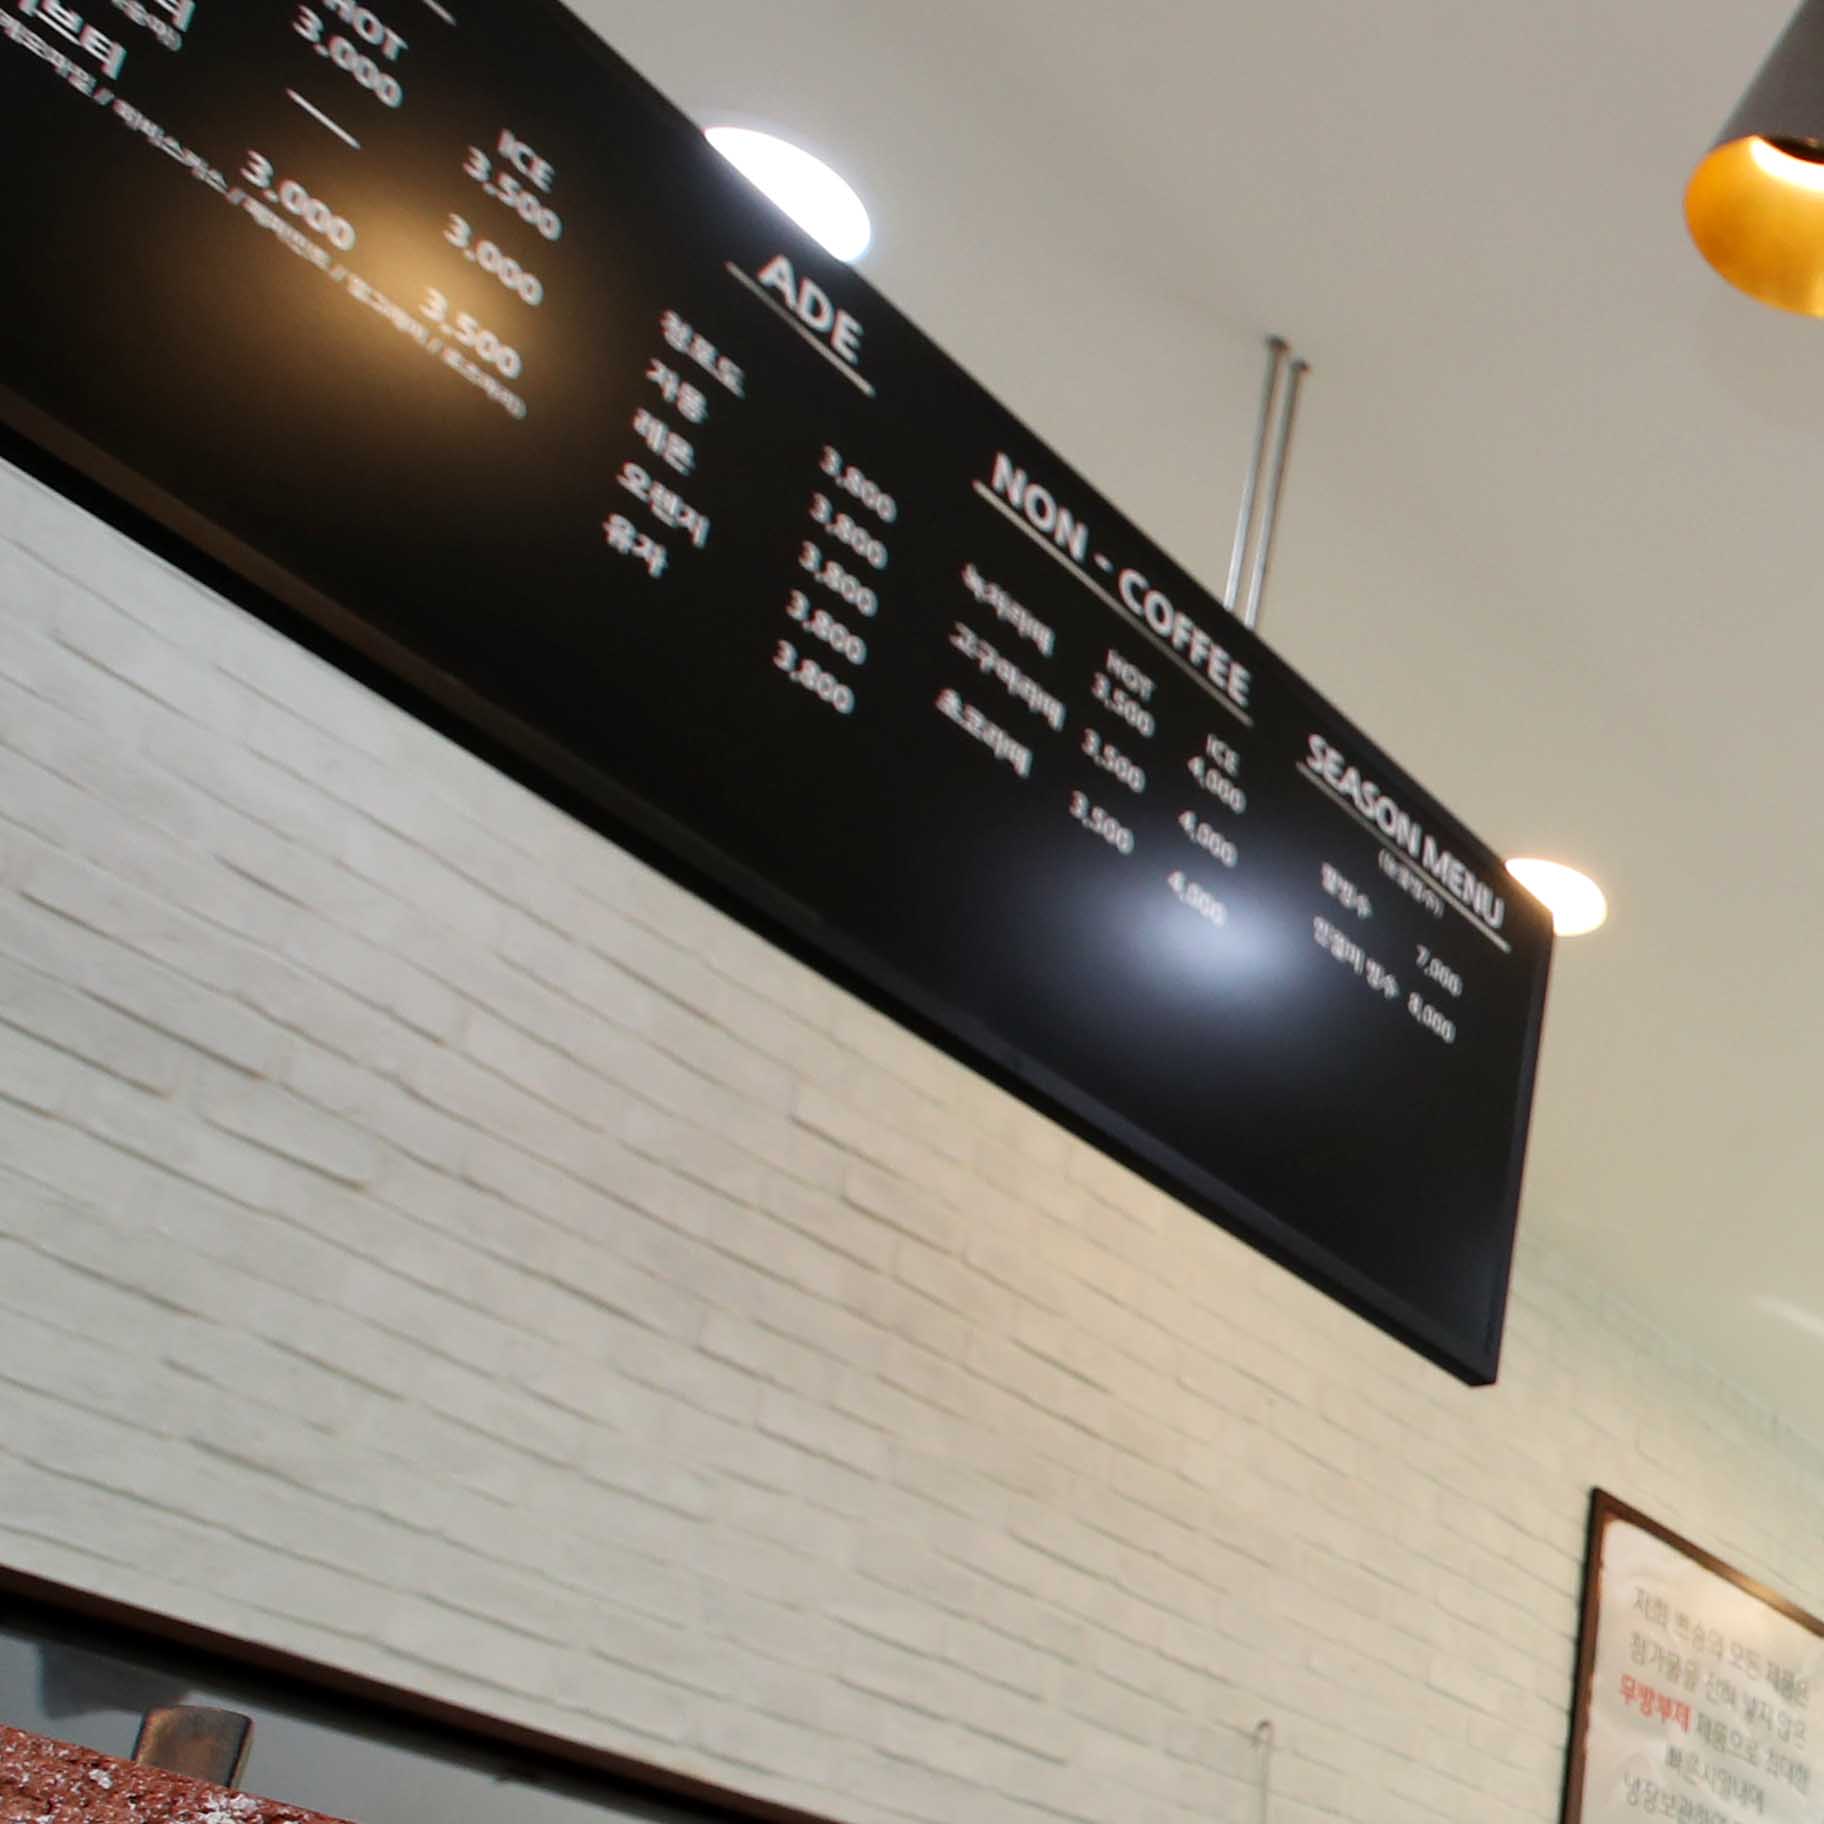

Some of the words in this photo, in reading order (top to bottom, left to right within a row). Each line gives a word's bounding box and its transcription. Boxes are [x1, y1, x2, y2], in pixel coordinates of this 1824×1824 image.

[497, 128, 555, 193] ICE
[758, 255, 863, 365] ADE
[616, 462, 710, 549] 오렌지
[991, 452, 1089, 562] NON
[1118, 567, 1254, 707] COFFEE
[1106, 647, 1157, 701] HOT
[1205, 733, 1240, 777] ICE
[1306, 733, 1422, 857] SEASON
[1422, 834, 1505, 930] MENU
